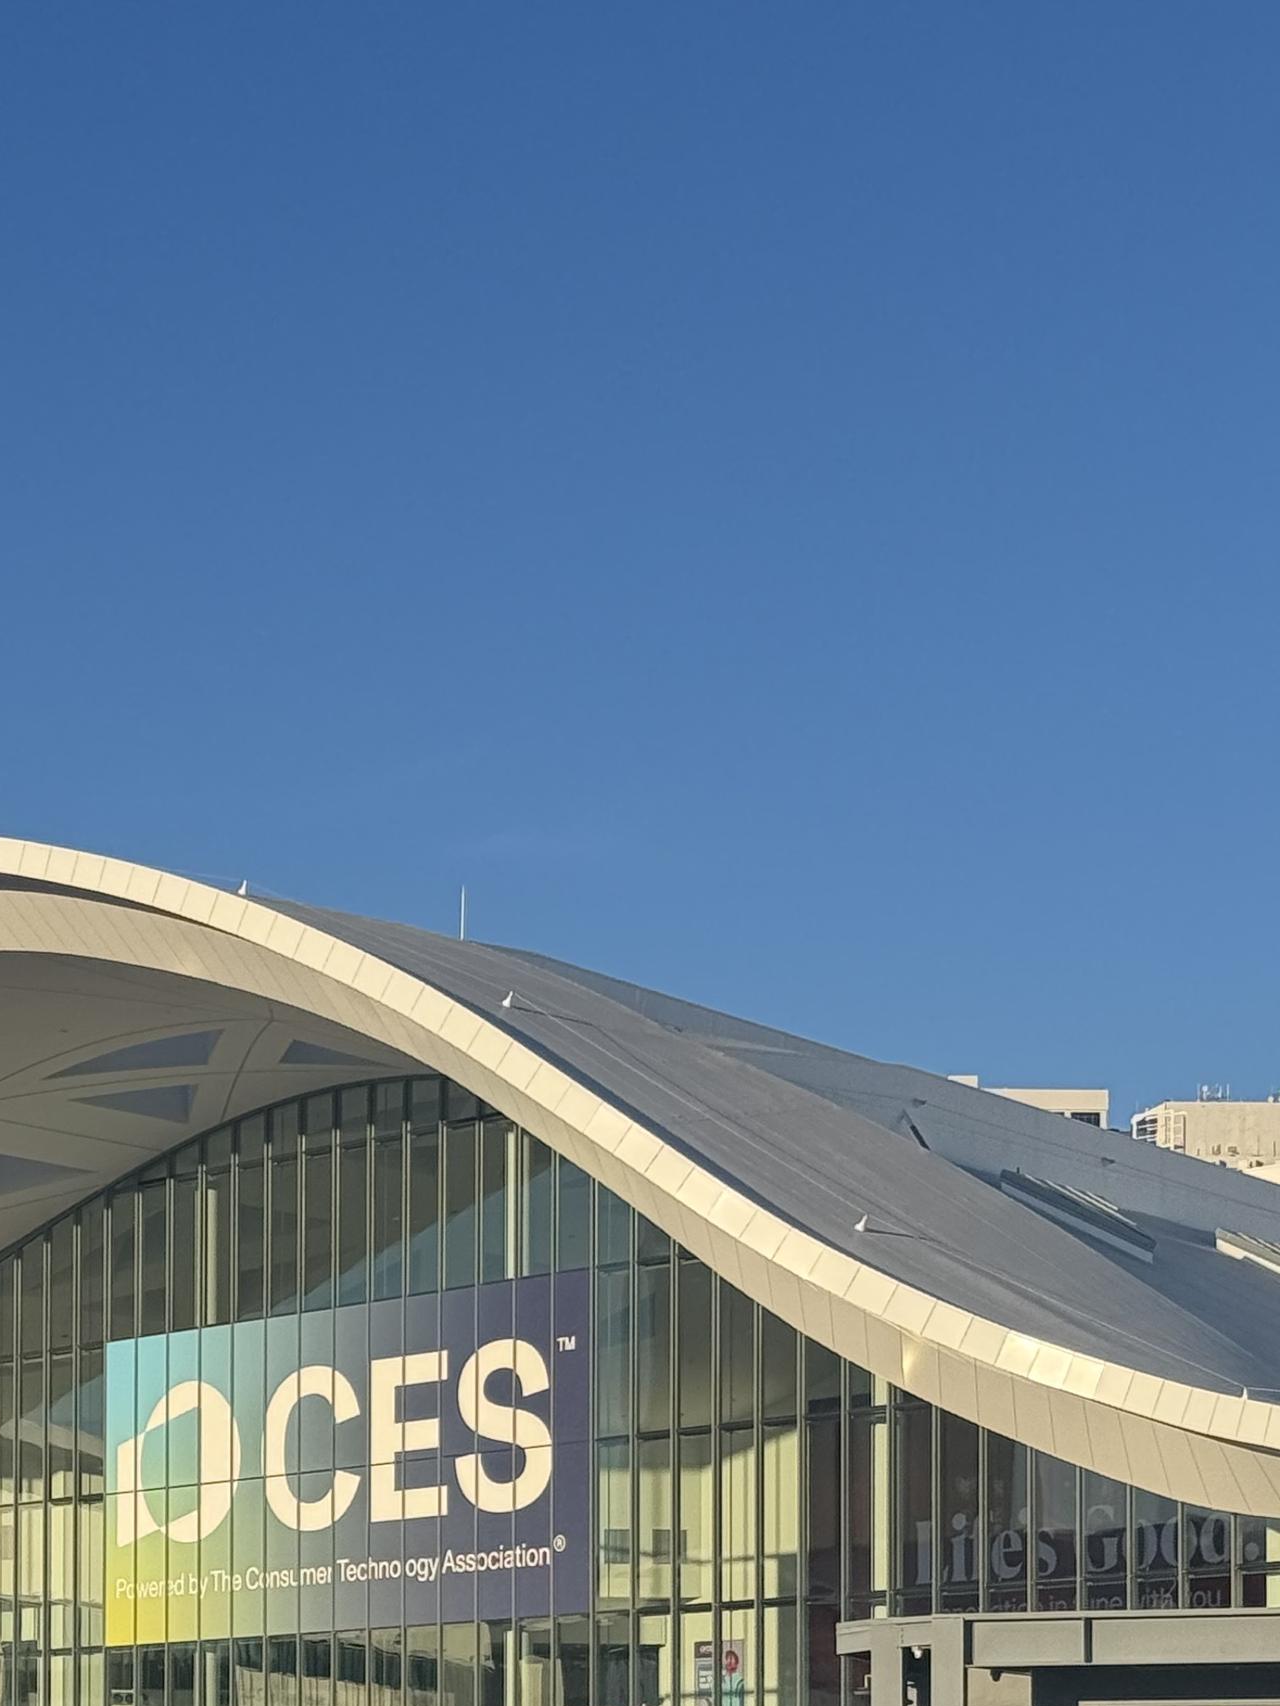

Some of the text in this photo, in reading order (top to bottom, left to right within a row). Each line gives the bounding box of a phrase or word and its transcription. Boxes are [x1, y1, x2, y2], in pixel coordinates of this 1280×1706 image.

[116, 1573, 185, 1599] Powered
[189, 1573, 209, 1599] by
[210, 1569, 242, 1592] The
[245, 1566, 333, 1591] Consumer
[336, 1557, 440, 1582] Technoogy
